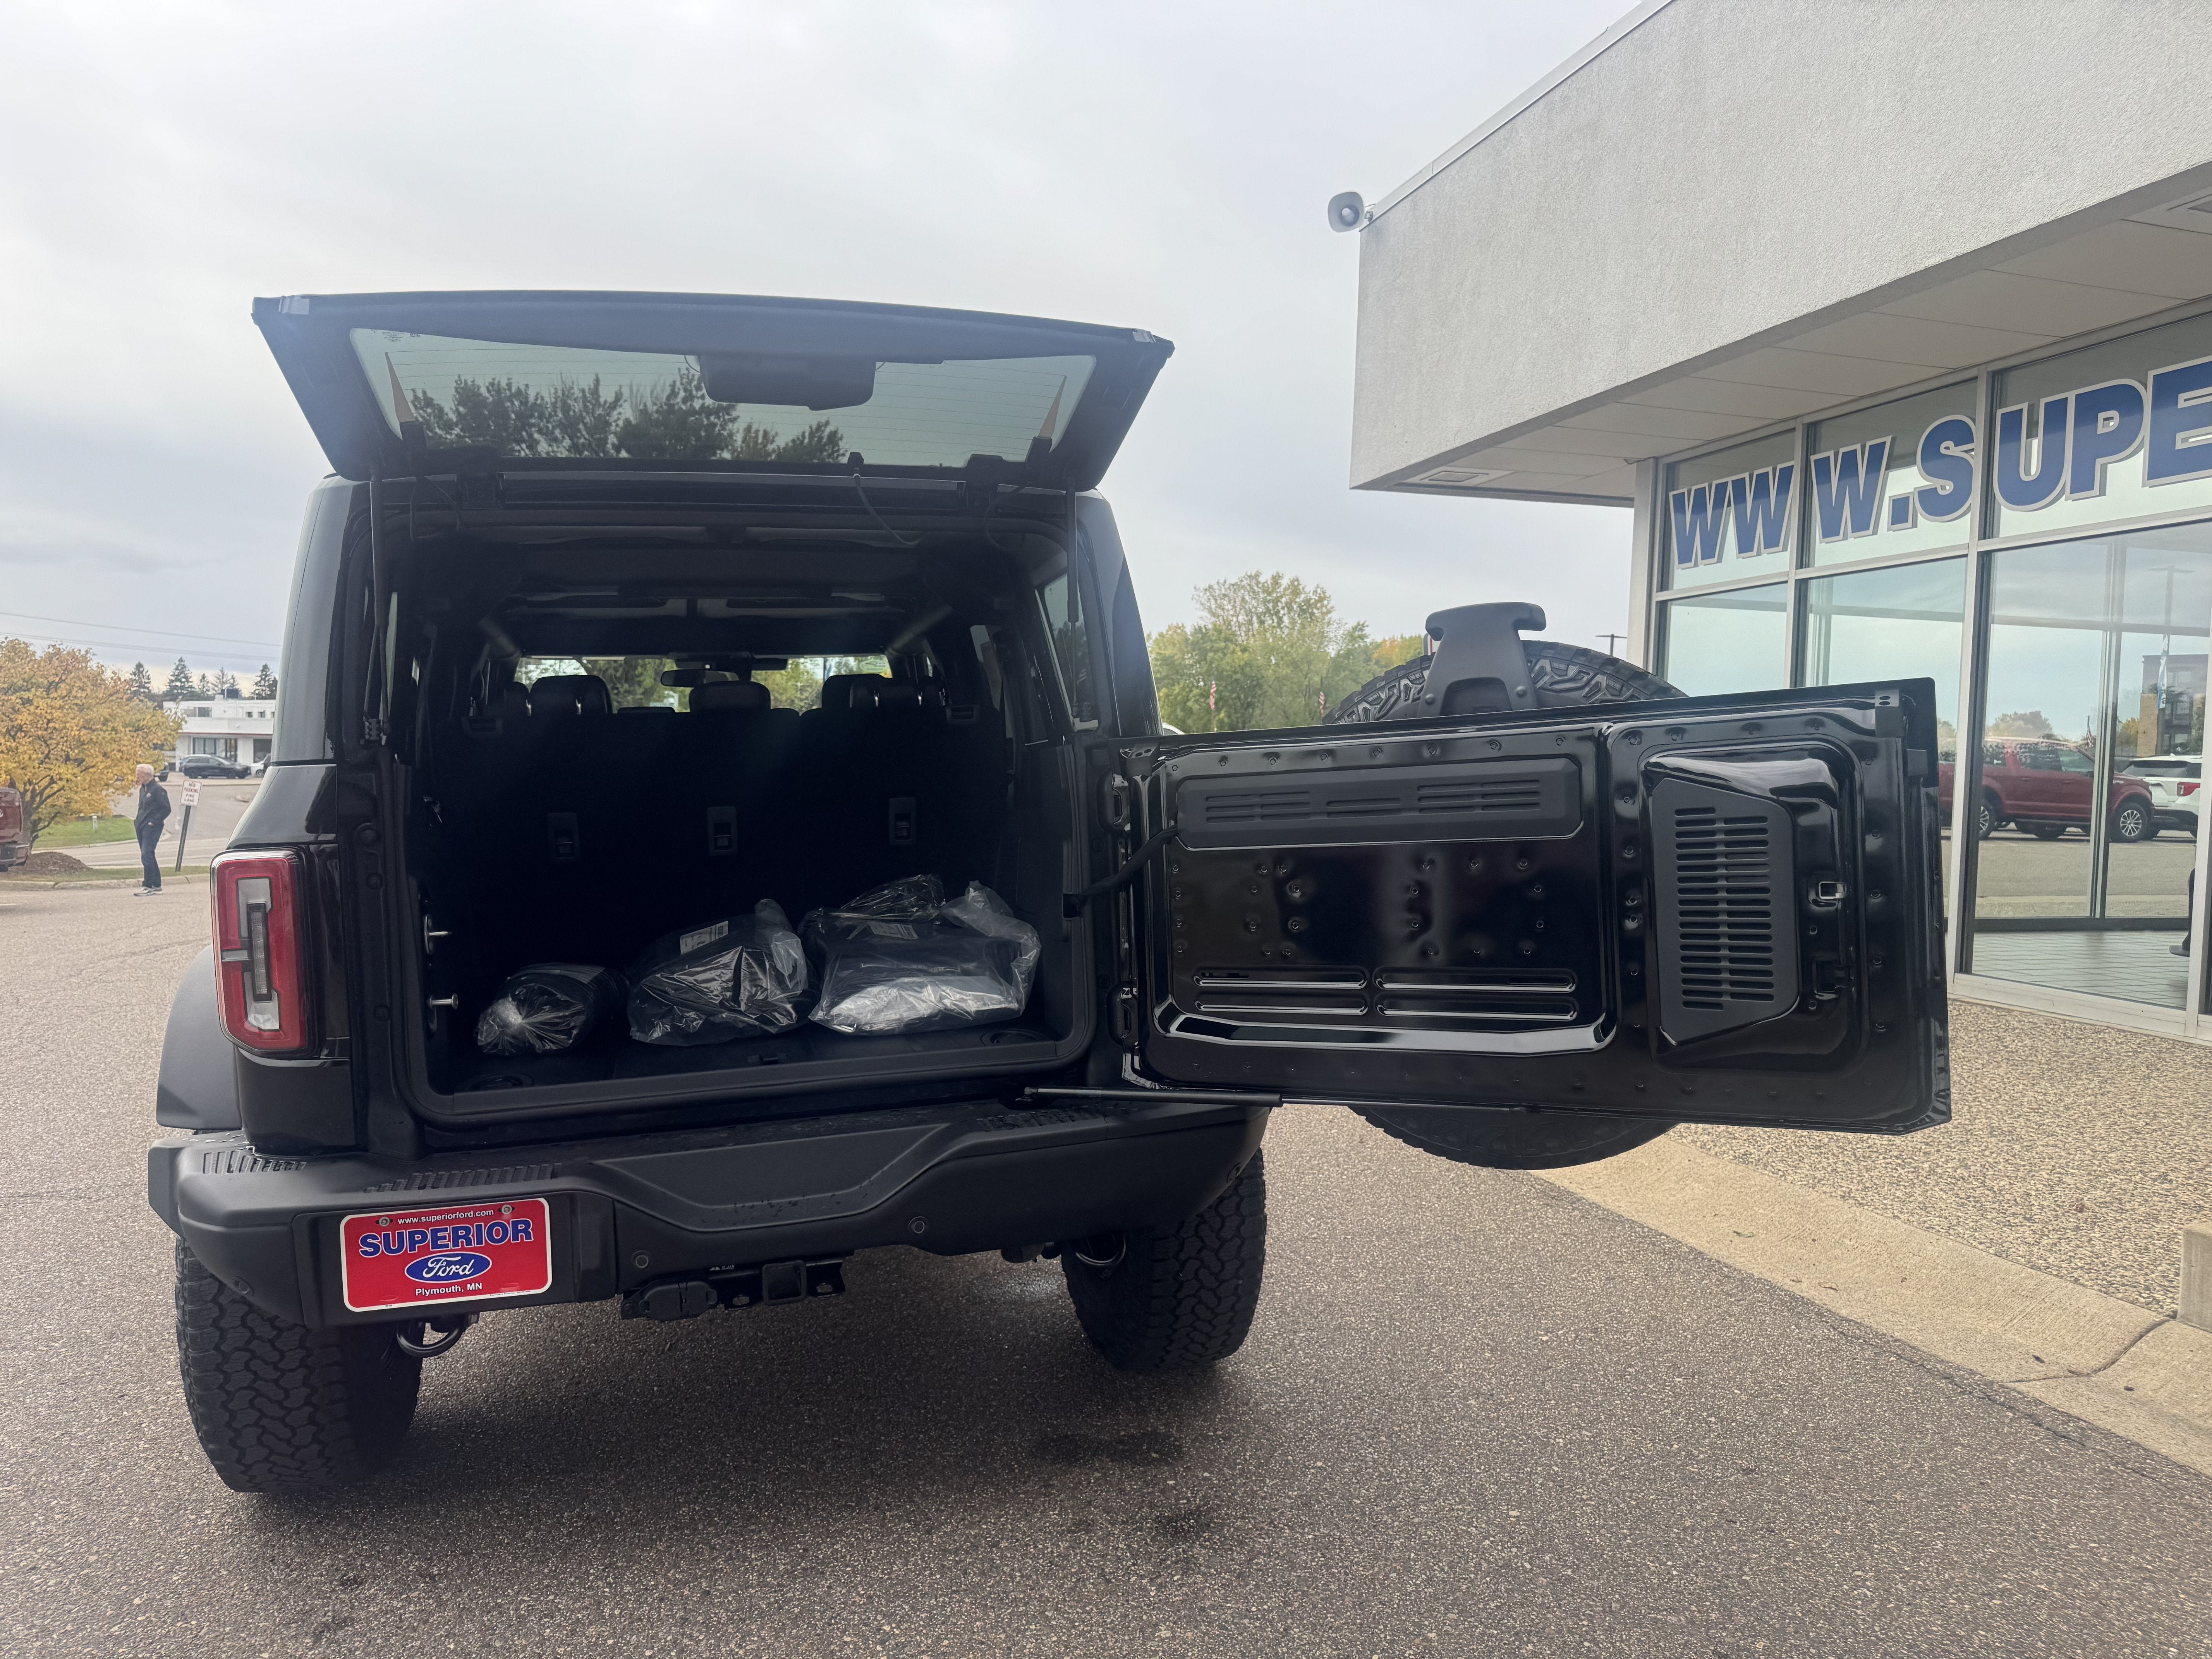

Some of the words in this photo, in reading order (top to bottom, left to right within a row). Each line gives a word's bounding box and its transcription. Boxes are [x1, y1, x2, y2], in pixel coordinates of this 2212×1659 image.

[397, 1209, 494, 1224] www.superiorford.com
[359, 1218, 534, 1258] SUPERIOR
[422, 1256, 475, 1278] Ford
[416, 1285, 464, 1297] Plymouth,
[467, 1282, 482, 1291] MN
